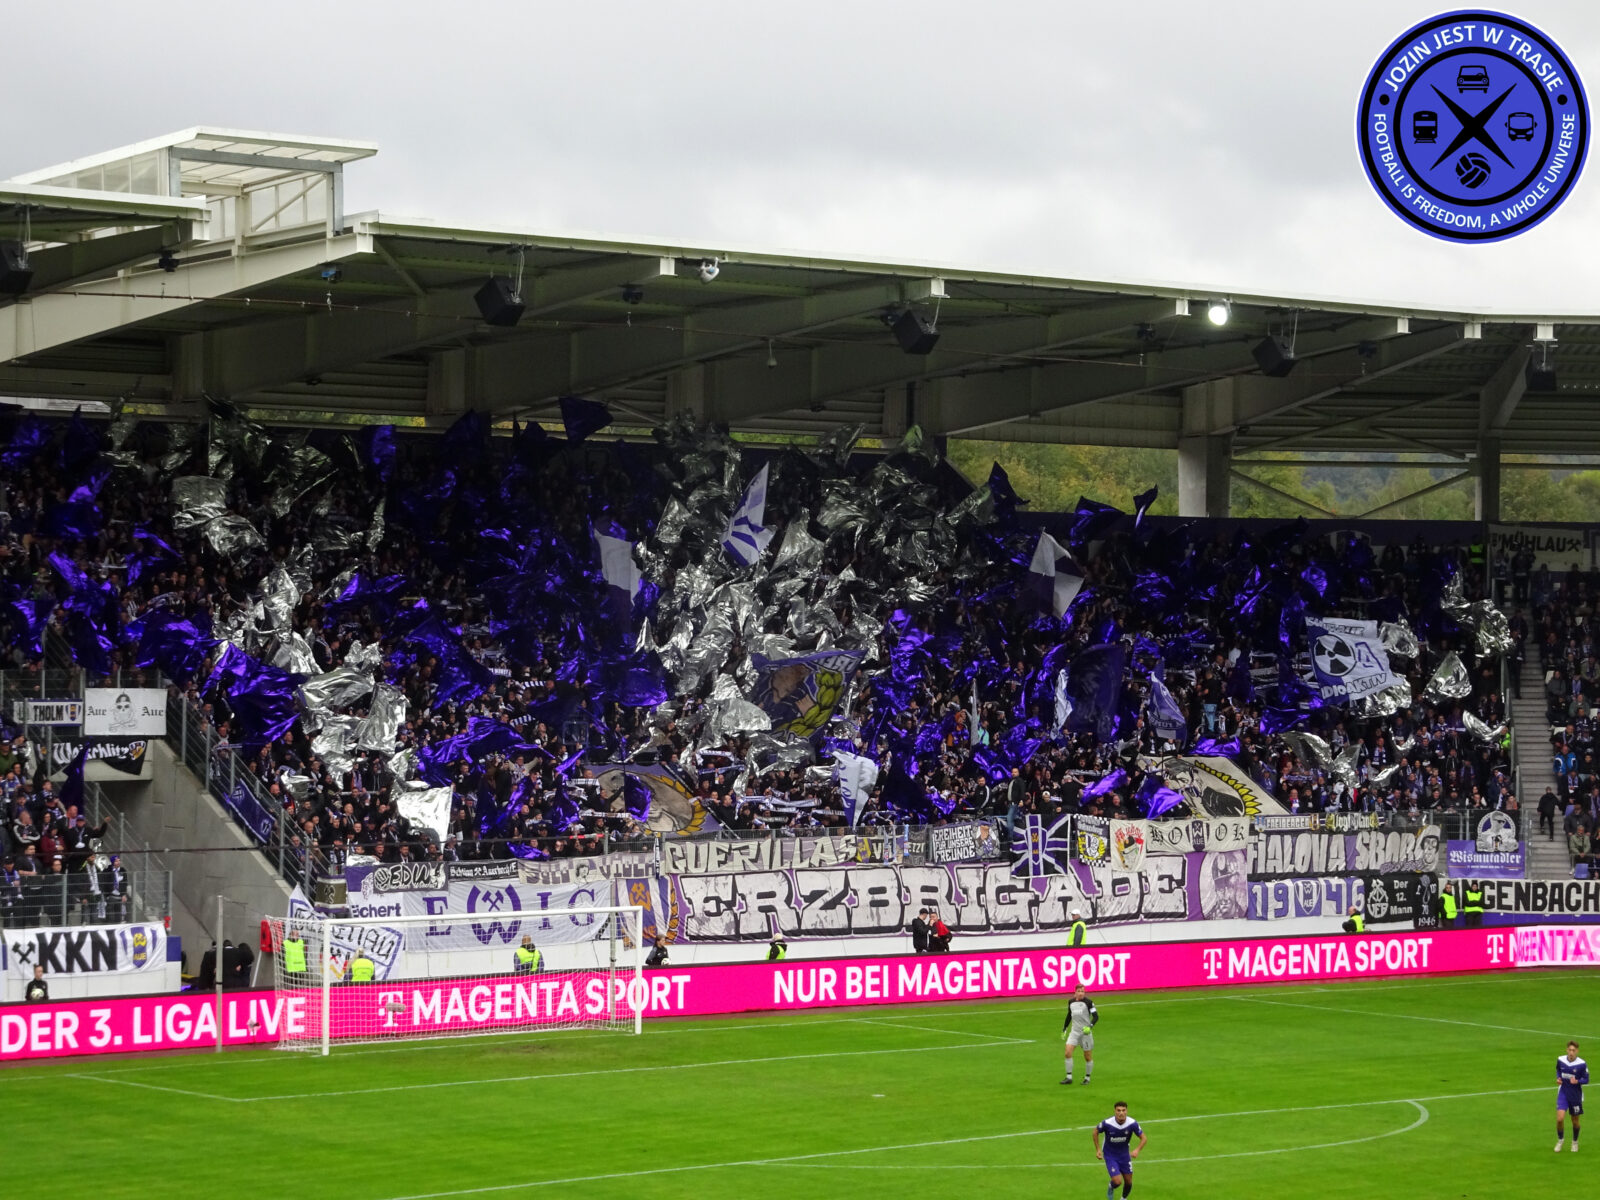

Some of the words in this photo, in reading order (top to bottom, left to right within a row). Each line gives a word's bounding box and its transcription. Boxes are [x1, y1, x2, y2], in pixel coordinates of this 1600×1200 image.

[1321, 673, 1387, 699] DIOAKTIV
[666, 835, 857, 874] GUERILLAS
[935, 845, 975, 862] FREUNDE
[1450, 851, 1521, 863] Wismutadler
[680, 856, 1188, 941] ERZBRIGADE
[1393, 880, 1408, 889] Der
[1396, 892, 1407, 901] 12.
[1390, 905, 1413, 915] Mann
[36, 929, 117, 974] KKN
[1228, 942, 1349, 978] MAGENTA
[1355, 938, 1432, 971] SPORT
[773, 966, 836, 1003] NUR
[848, 964, 889, 999] BEI
[899, 957, 1036, 996] MAGENTA
[1043, 953, 1131, 988] SPORT
[413, 980, 580, 1026] MAGENTA
[585, 974, 691, 1015] SPORT
[1, 1011, 79, 1053] DER
[89, 1008, 122, 1048] 3.
[133, 1000, 217, 1044] LIGA
[229, 997, 305, 1038] LIVE
